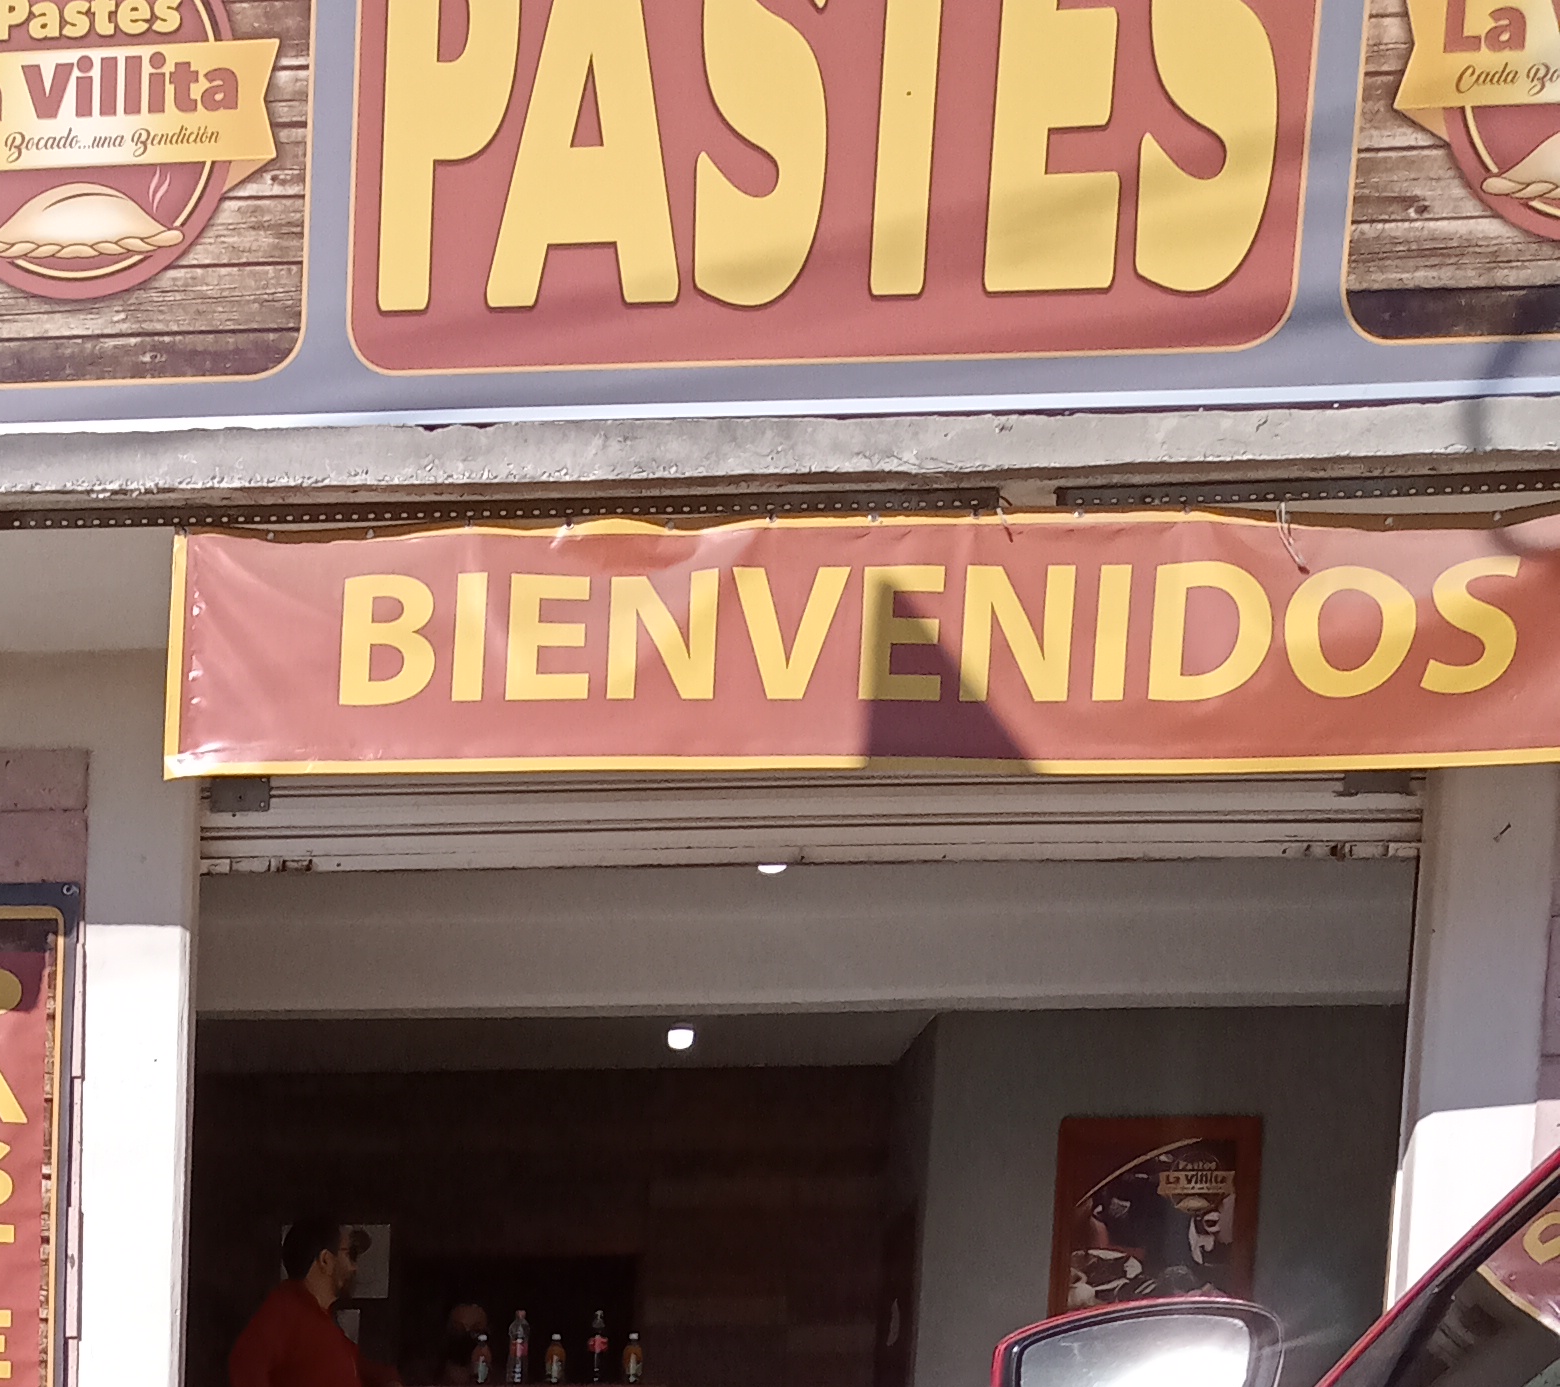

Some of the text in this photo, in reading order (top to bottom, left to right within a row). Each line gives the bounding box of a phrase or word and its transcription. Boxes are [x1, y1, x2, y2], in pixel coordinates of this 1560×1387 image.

[1442, 0, 1526, 53] La
[21, 51, 239, 120] Villita
[1455, 62, 1520, 94] Cada
[131, 124, 220, 158] Bendición
[338, 556, 1522, 706] BIENVENIDOS
